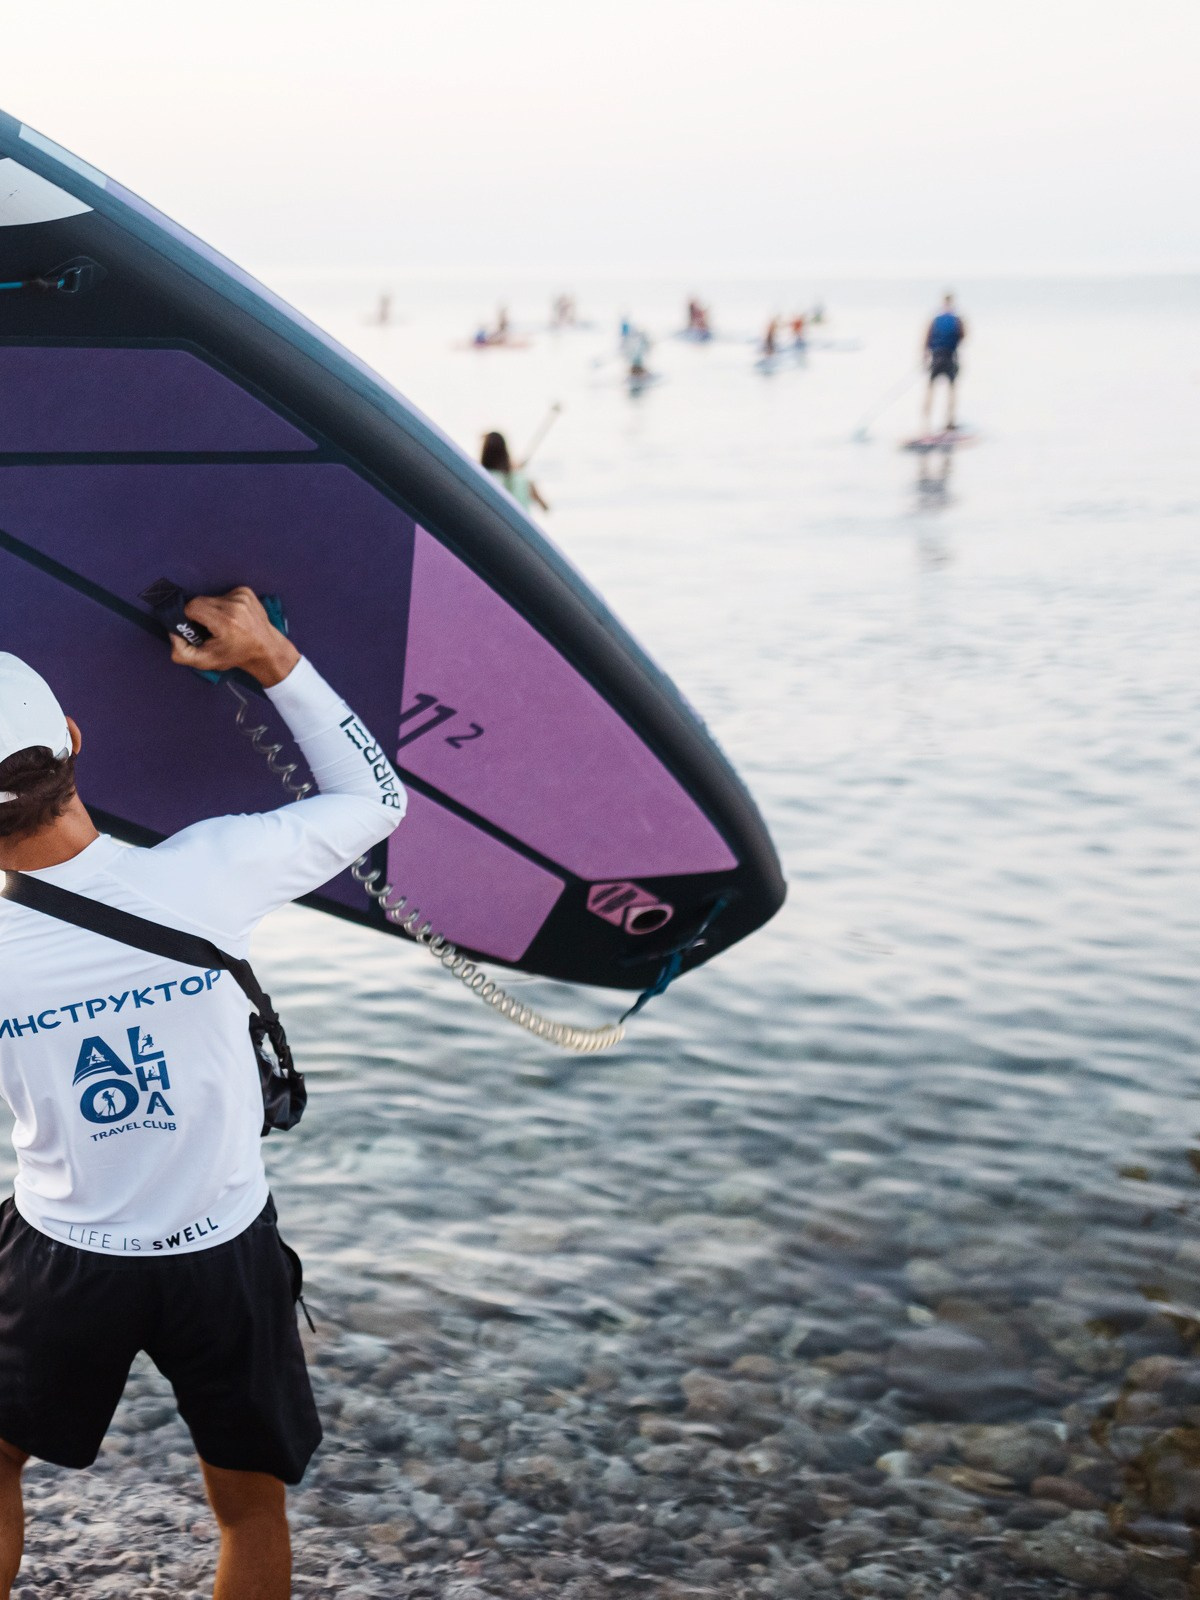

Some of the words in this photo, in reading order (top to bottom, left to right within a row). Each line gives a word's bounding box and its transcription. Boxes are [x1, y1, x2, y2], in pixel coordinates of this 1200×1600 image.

[90, 1122, 141, 1142] TRAVEL
[142, 1120, 177, 1132] CLUB
[68, 1225, 112, 1249] LIFE
[123, 1237, 142, 1251] IS
